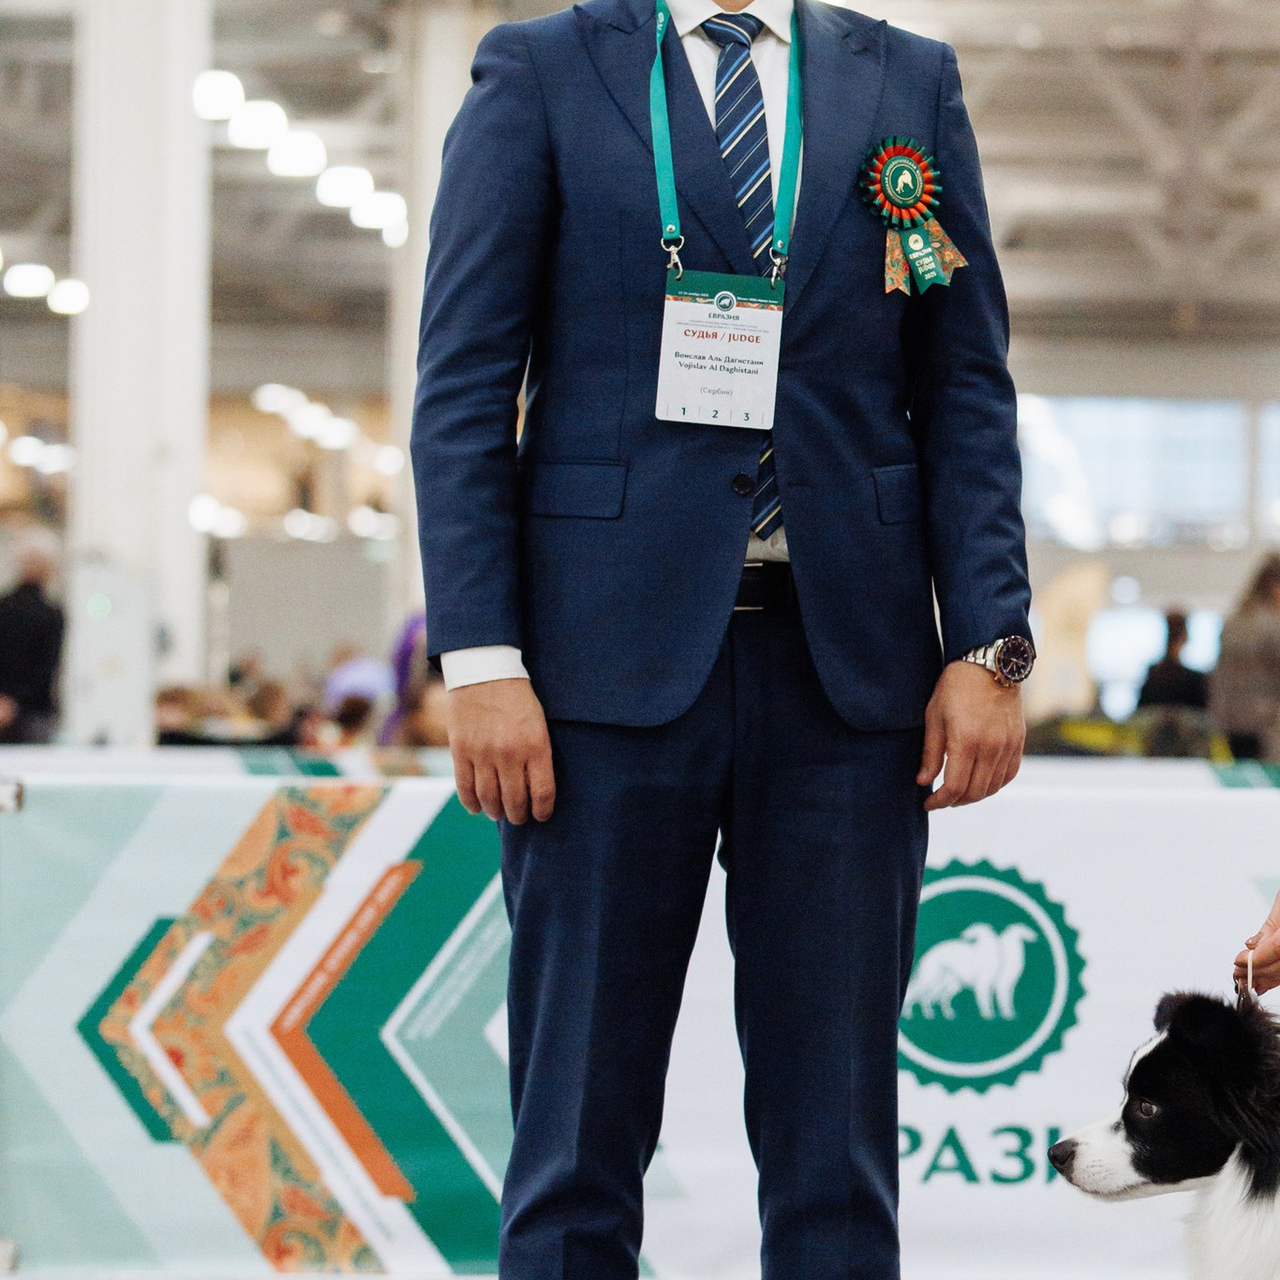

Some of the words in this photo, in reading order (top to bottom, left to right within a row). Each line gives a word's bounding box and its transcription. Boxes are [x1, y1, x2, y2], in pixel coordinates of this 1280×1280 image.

[708, 312, 740, 321] ЕВРАЗИЯ
[683, 328, 718, 340] СУДЬЯ
[728, 333, 762, 343] JUDGE
[678, 361, 708, 371] Vojislav
[719, 365, 759, 375] Daghistani
[681, 407, 686, 416] 1
[712, 409, 719, 419] 2
[743, 412, 750, 422] 3
